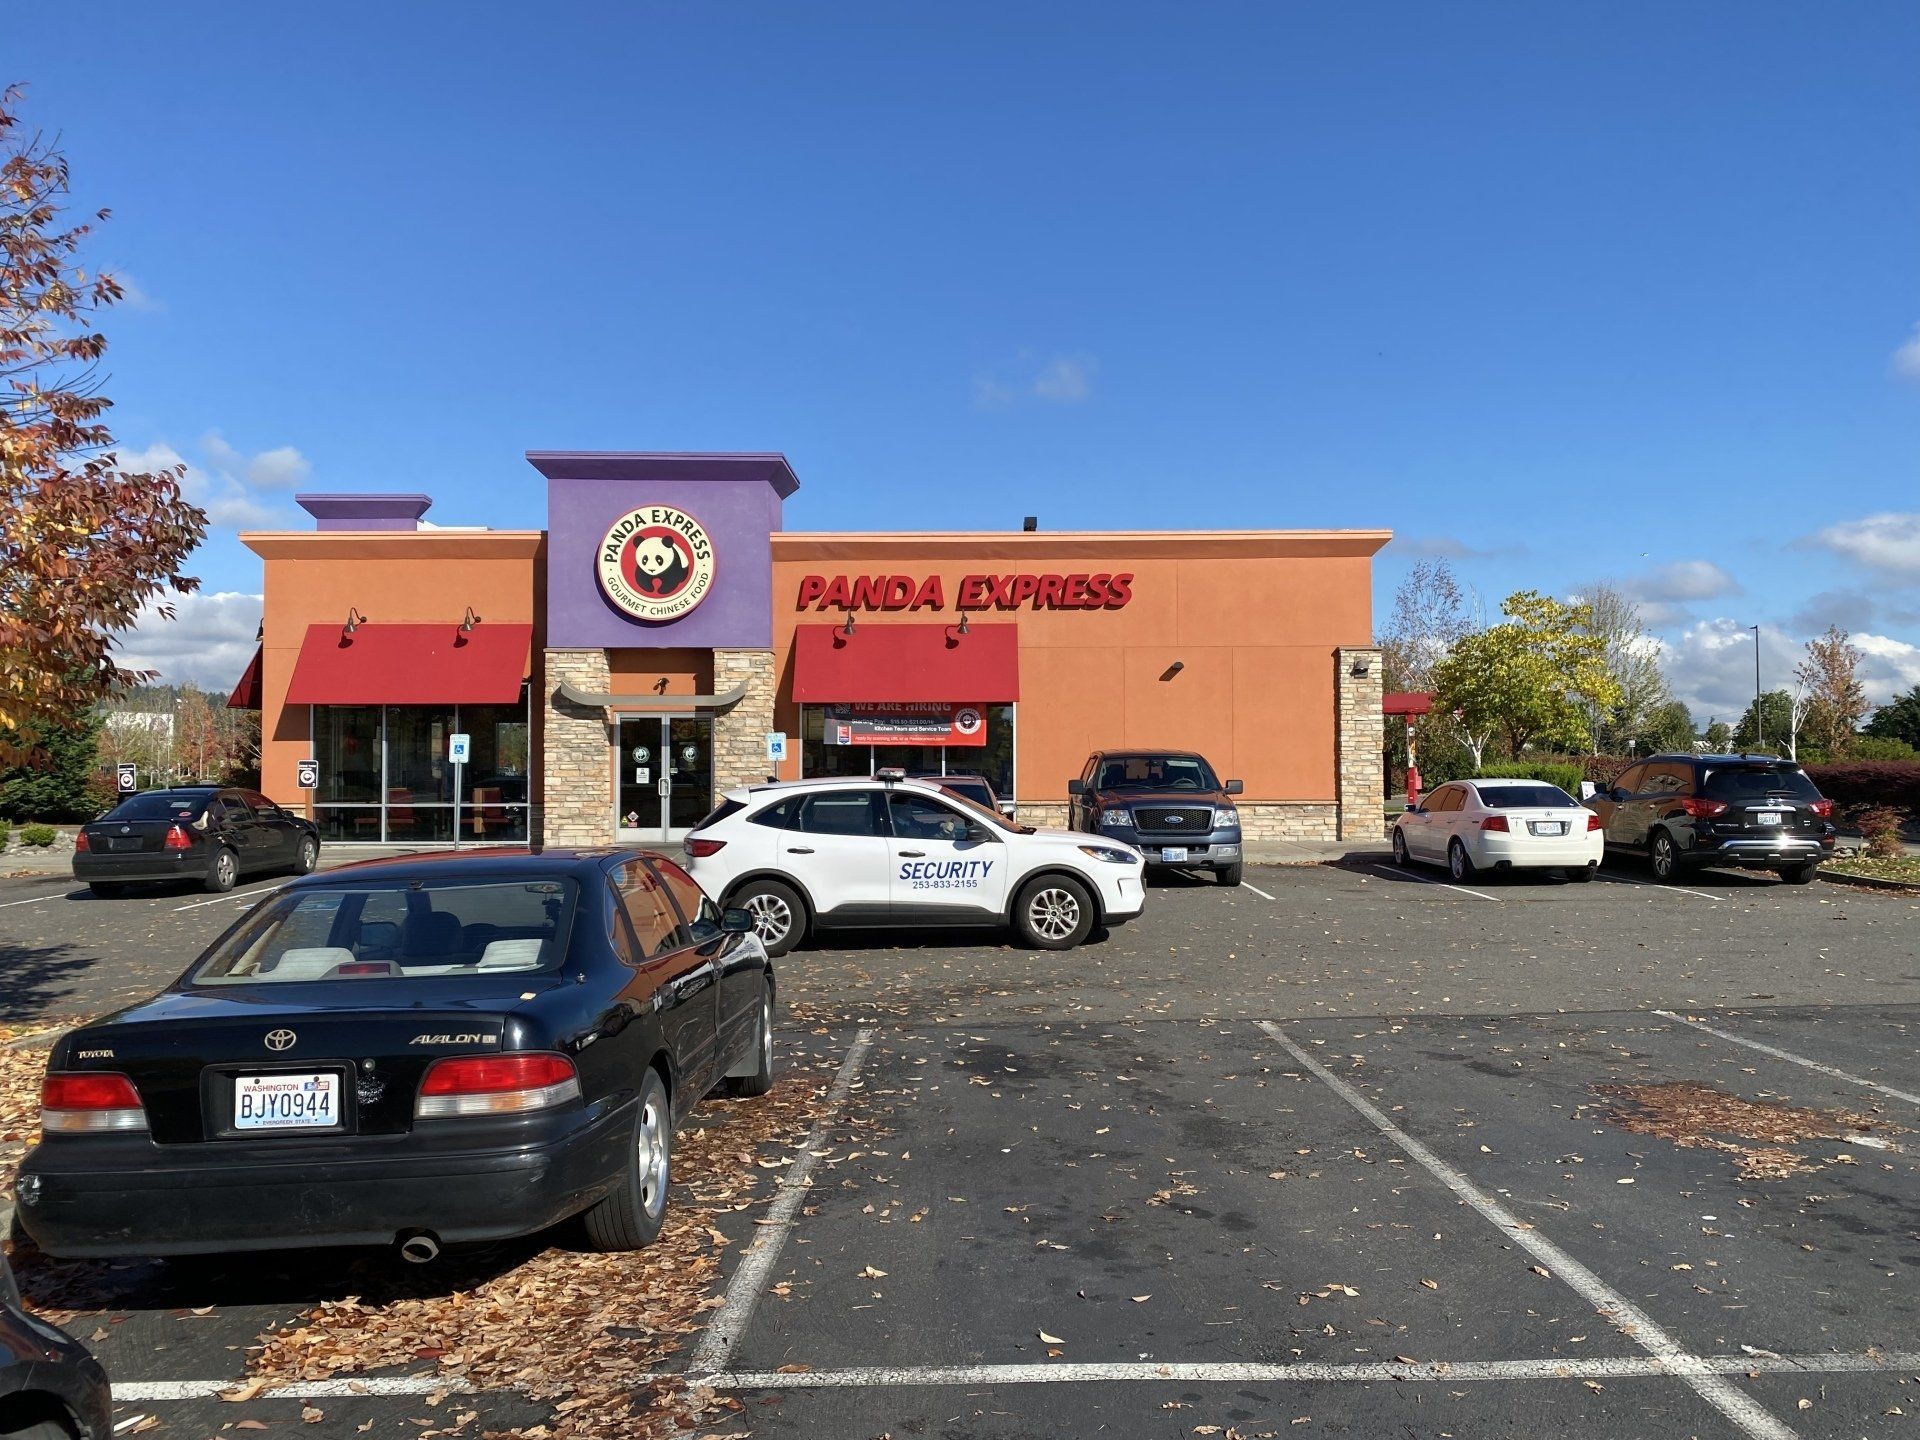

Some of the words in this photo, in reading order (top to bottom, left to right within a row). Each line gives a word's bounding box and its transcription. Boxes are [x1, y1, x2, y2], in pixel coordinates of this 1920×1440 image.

[604, 513, 647, 563] PANDA
[651, 509, 711, 560] EXPRESS
[607, 577, 647, 613] GOURMET
[650, 597, 691, 615] CHINESE
[690, 572, 709, 599] FOOD
[797, 575, 945, 611] PANDA
[957, 573, 1135, 611] EXPRESS
[855, 702, 874, 711] WE
[877, 702, 902, 711] ARE
[905, 702, 951, 711] HIRING
[900, 861, 994, 880] SECURITY
[913, 880, 978, 889] 253-833-2155
[409, 1034, 481, 1044] AVALON
[78, 1050, 114, 1059] TOYOTA
[244, 1084, 299, 1092] WASHINGTON
[241, 1092, 330, 1119] BJY0944
